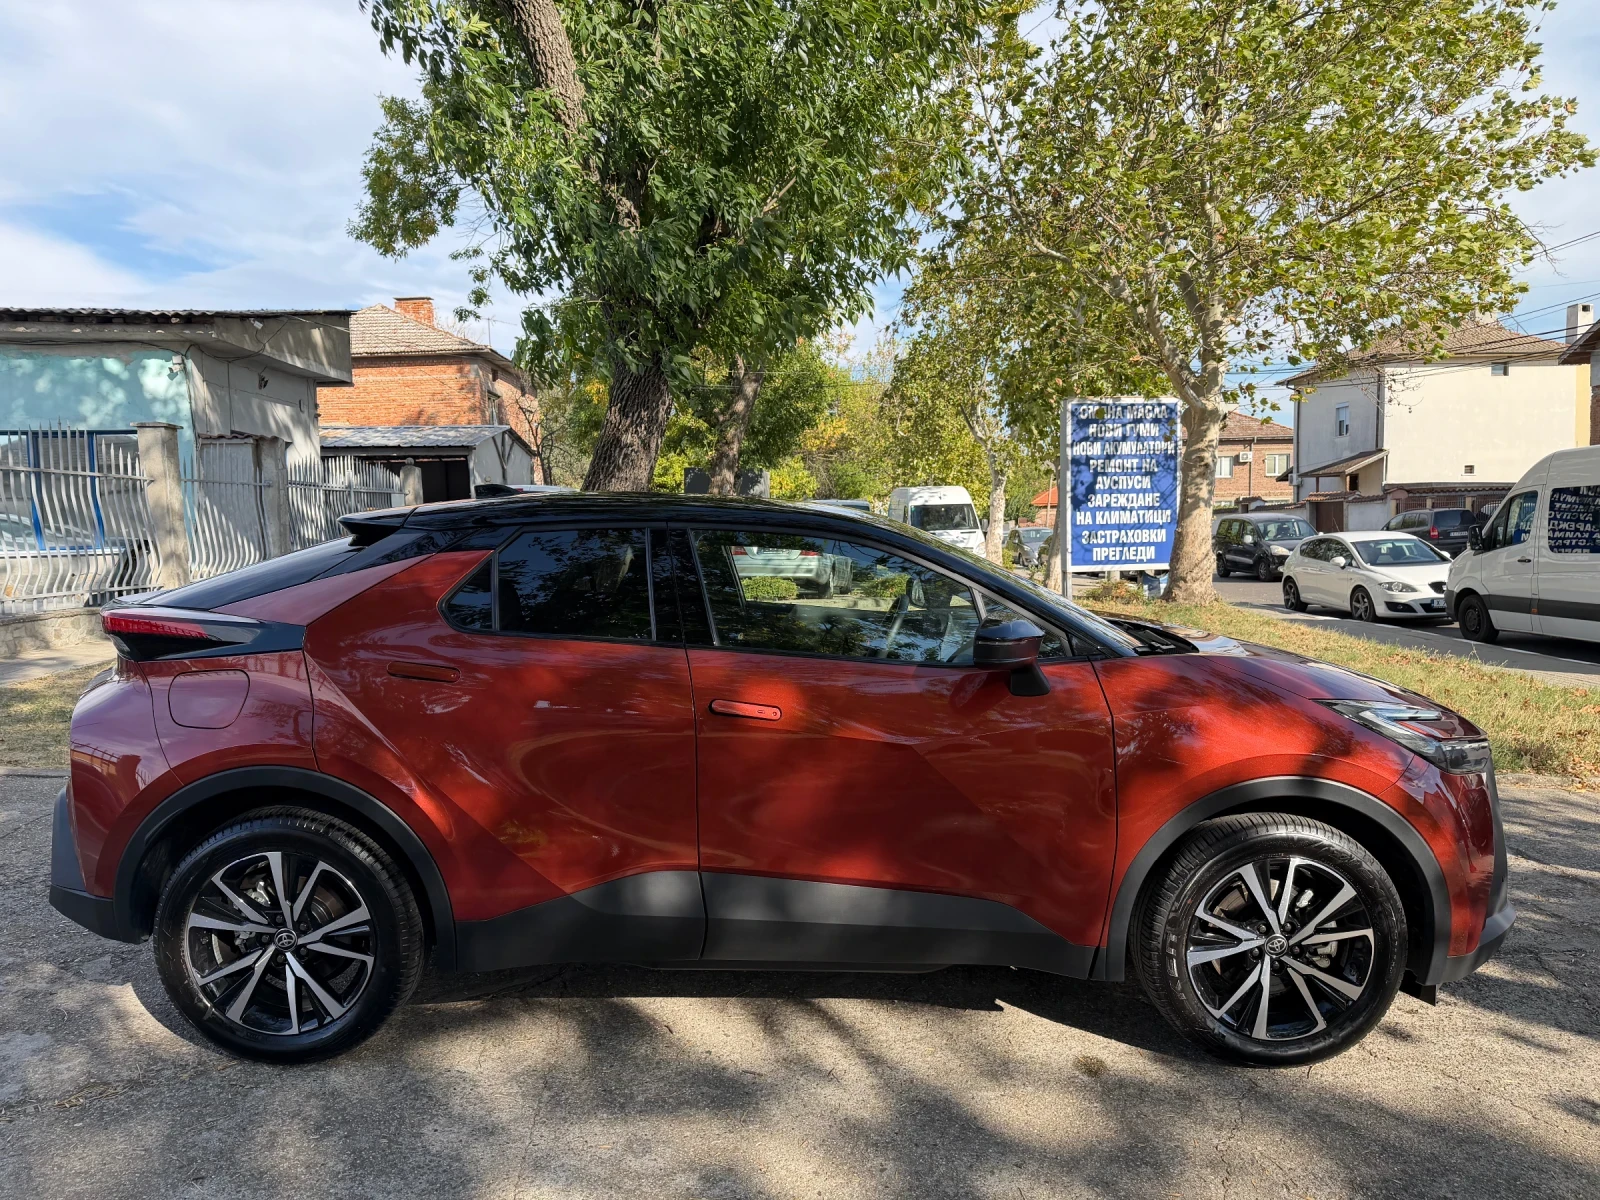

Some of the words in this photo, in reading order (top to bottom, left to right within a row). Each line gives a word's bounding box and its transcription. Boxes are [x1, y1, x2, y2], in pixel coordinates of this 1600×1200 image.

[1080, 406, 1123, 419] СМНА
[1126, 405, 1168, 419] МАСЛА
[1089, 424, 1122, 438] НОВИ
[1126, 423, 1159, 437] ГУМИ
[1073, 441, 1101, 456] НОВИ
[1104, 440, 1175, 456] АКУМУЛАТОРИ
[1090, 459, 1139, 473] РЕМОНТ
[1142, 458, 1158, 472] НА
[1096, 475, 1151, 490] АУСПУСИ
[1088, 493, 1160, 509] ЗАРЕЖДАНЕ
[1076, 511, 1093, 525] НА
[1096, 510, 1171, 525] КЛИМАТИЦИ
[1082, 529, 1166, 544] ЗАСТРАХОВКИ
[1093, 546, 1155, 562] ПРЕГЛЕДИ
